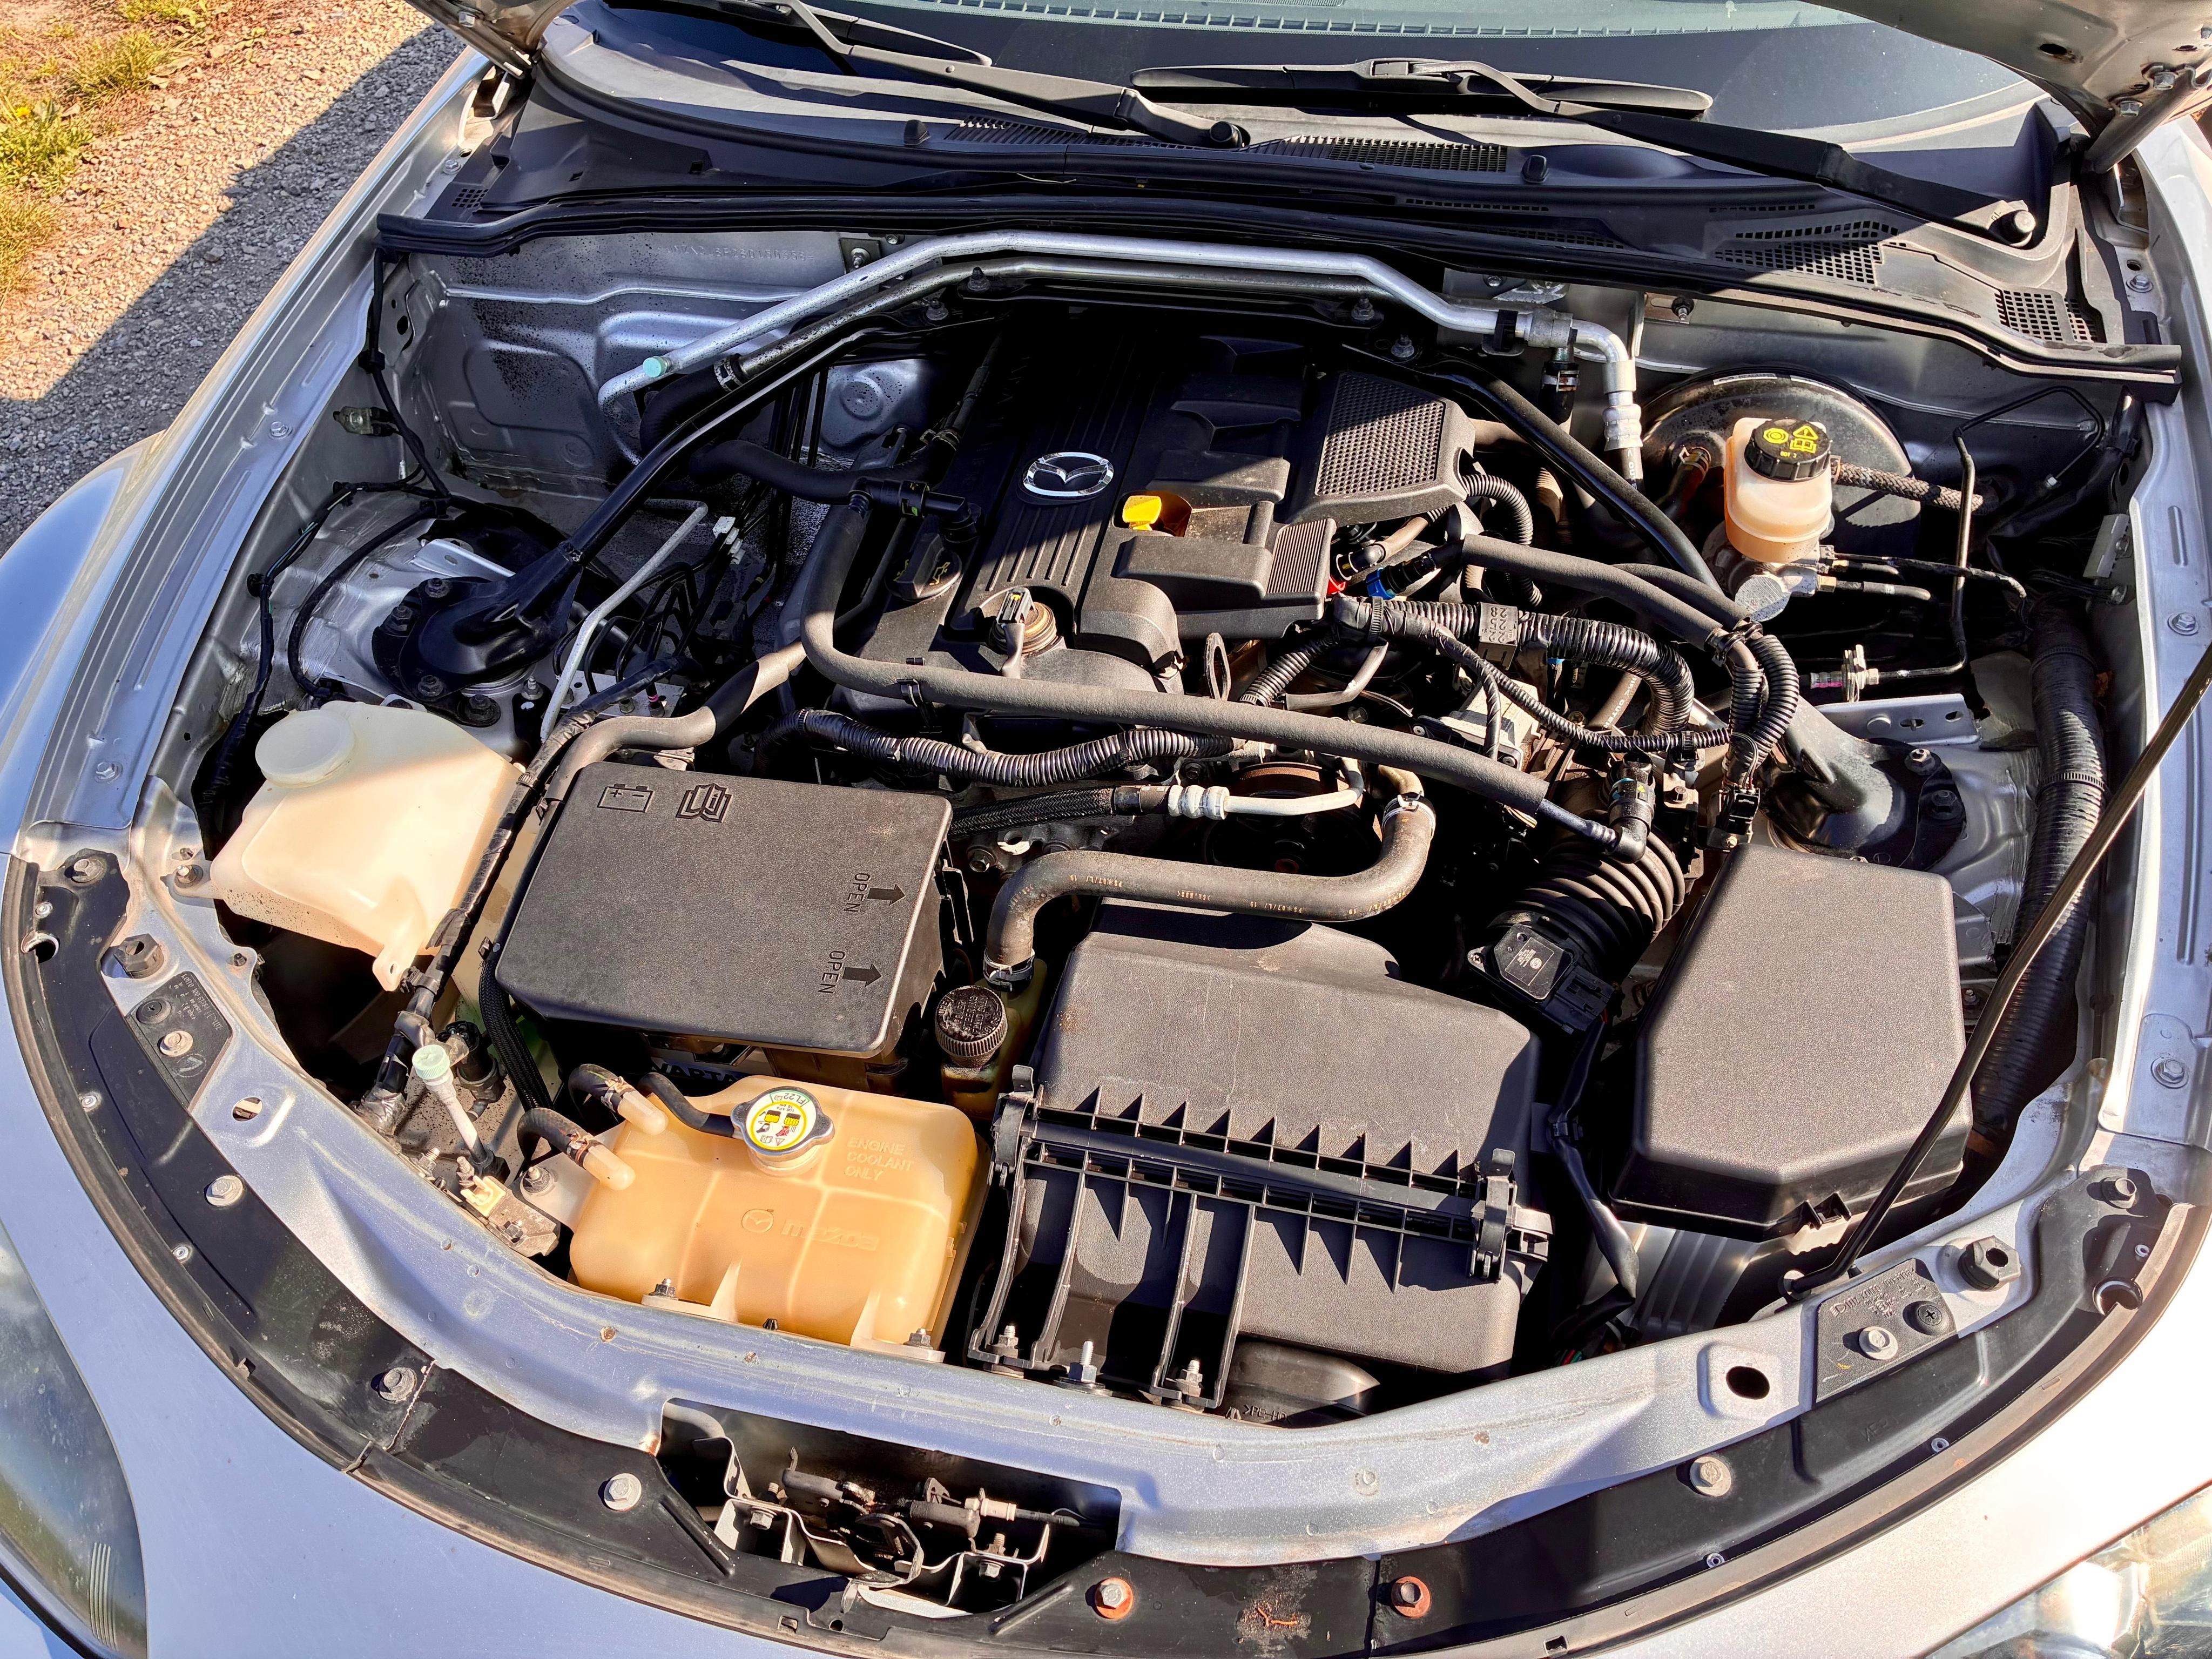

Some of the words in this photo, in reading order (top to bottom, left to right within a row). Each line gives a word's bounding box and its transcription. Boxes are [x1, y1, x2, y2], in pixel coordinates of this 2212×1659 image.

[844, 873, 872, 913] OPEN
[818, 950, 846, 994] OPEN
[784, 1092, 806, 1104] FL22
[847, 1136, 906, 1155] ENGINE
[846, 1151, 914, 1171] COOLANT
[844, 1165, 884, 1181] ONLY
